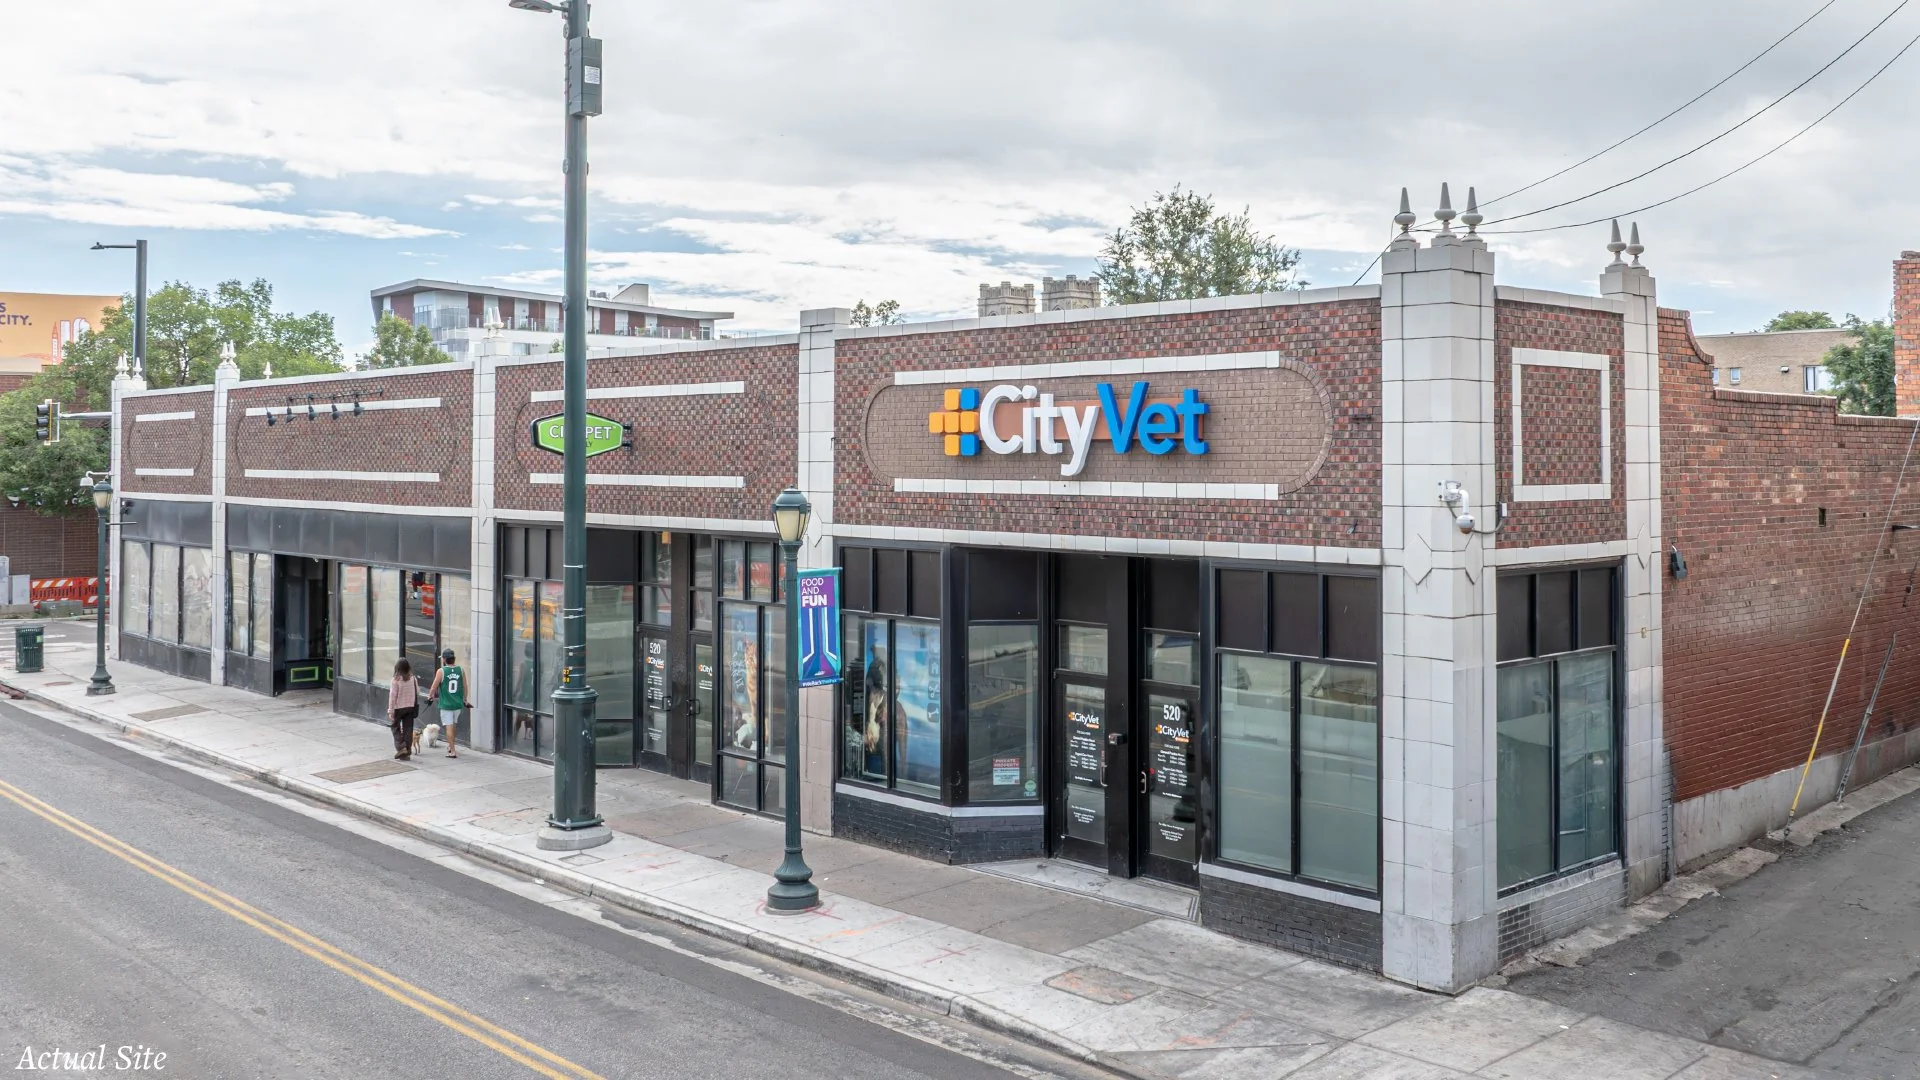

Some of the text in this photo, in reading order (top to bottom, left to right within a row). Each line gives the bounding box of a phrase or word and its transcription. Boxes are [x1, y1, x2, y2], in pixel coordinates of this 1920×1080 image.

[979, 382, 1210, 476] CityVet
[802, 578, 824, 587] FOOD
[802, 586, 820, 595] AND
[802, 595, 828, 607] FUN
[650, 642, 661, 654] 520
[448, 680, 458, 693] 0
[1163, 704, 1181, 721] 520
[1075, 713, 1099, 725] CityVet
[1162, 725, 1189, 738] CityVet
